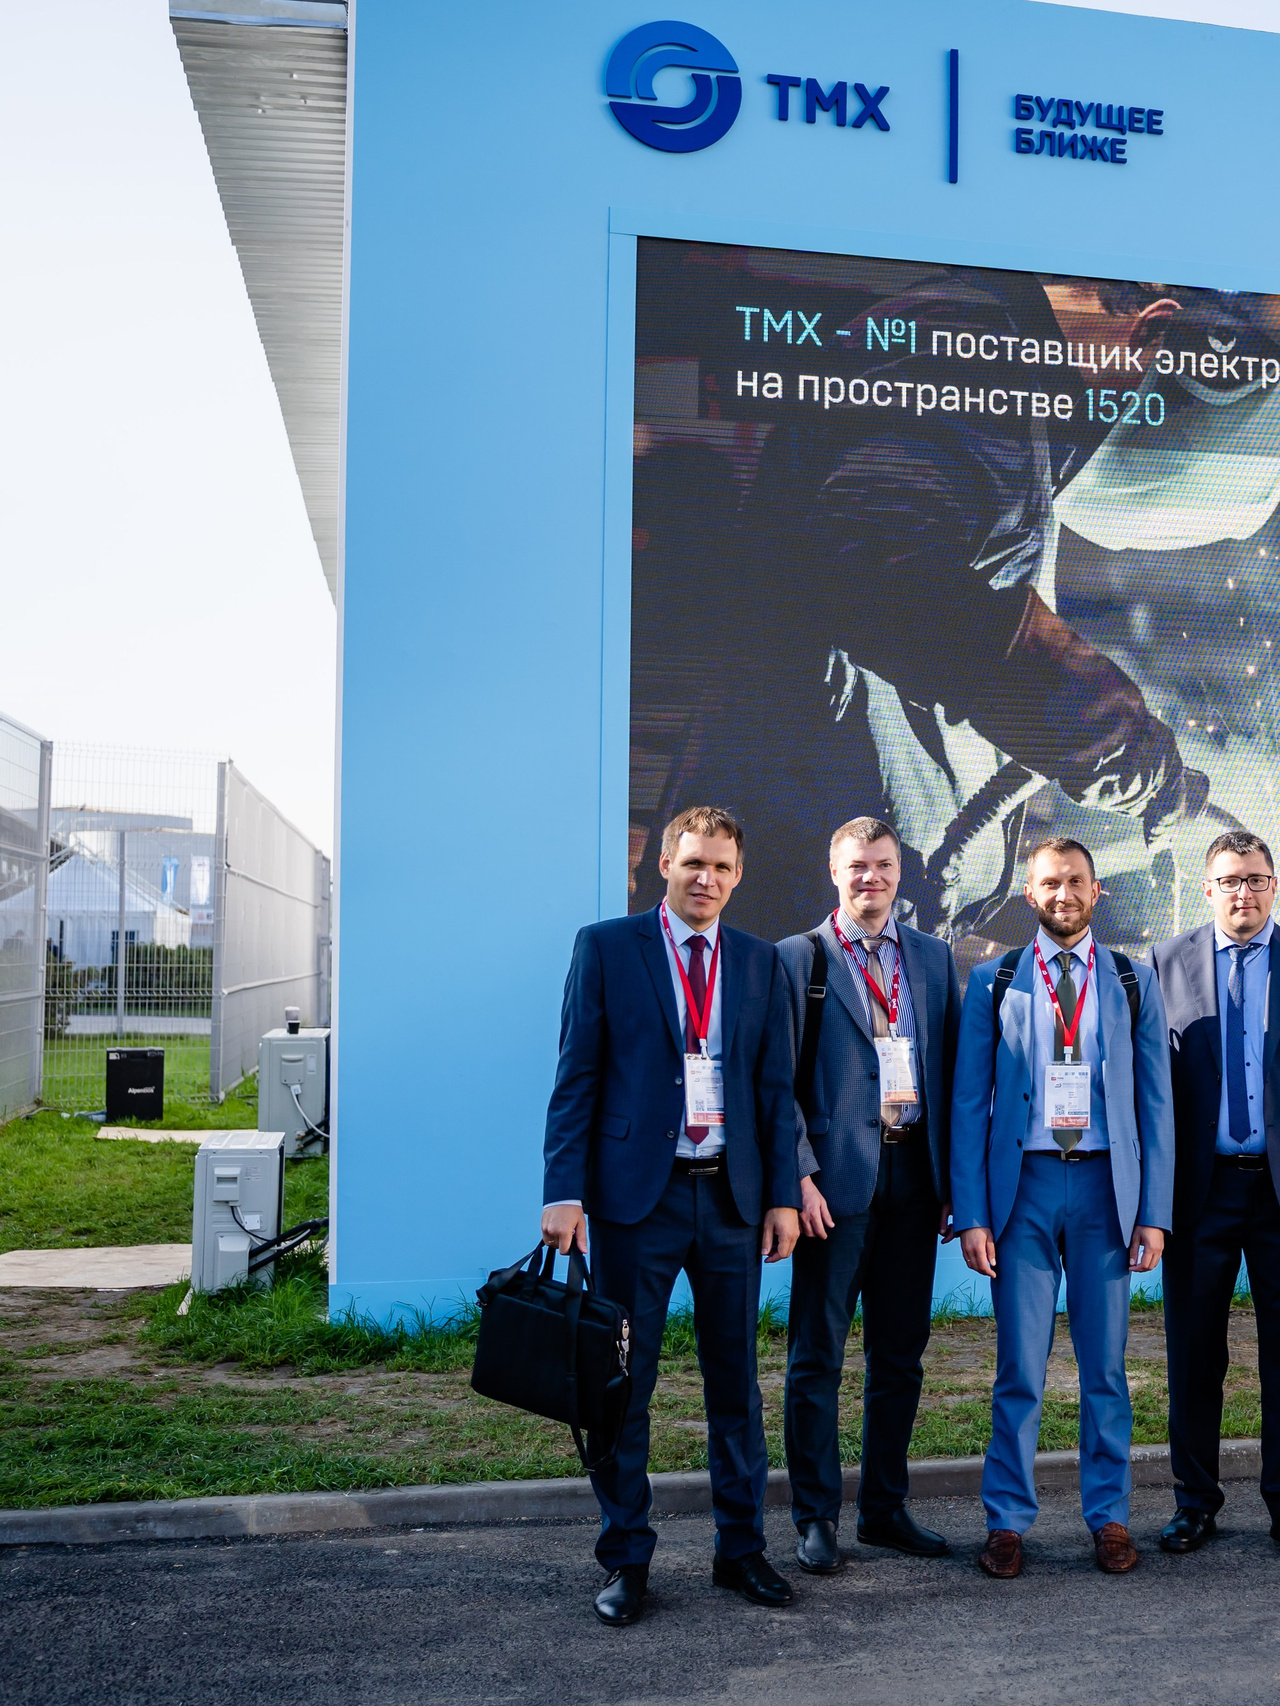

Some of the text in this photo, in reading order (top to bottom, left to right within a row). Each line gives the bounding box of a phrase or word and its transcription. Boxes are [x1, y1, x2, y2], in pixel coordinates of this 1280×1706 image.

[1014, 93, 1164, 135] БУДУЩЕЕ
[1015, 127, 1128, 164] БЛИЖЕ
[865, 316, 917, 355] №1
[931, 329, 1144, 375] поставщик
[736, 370, 1166, 427] на пространстве 1520
